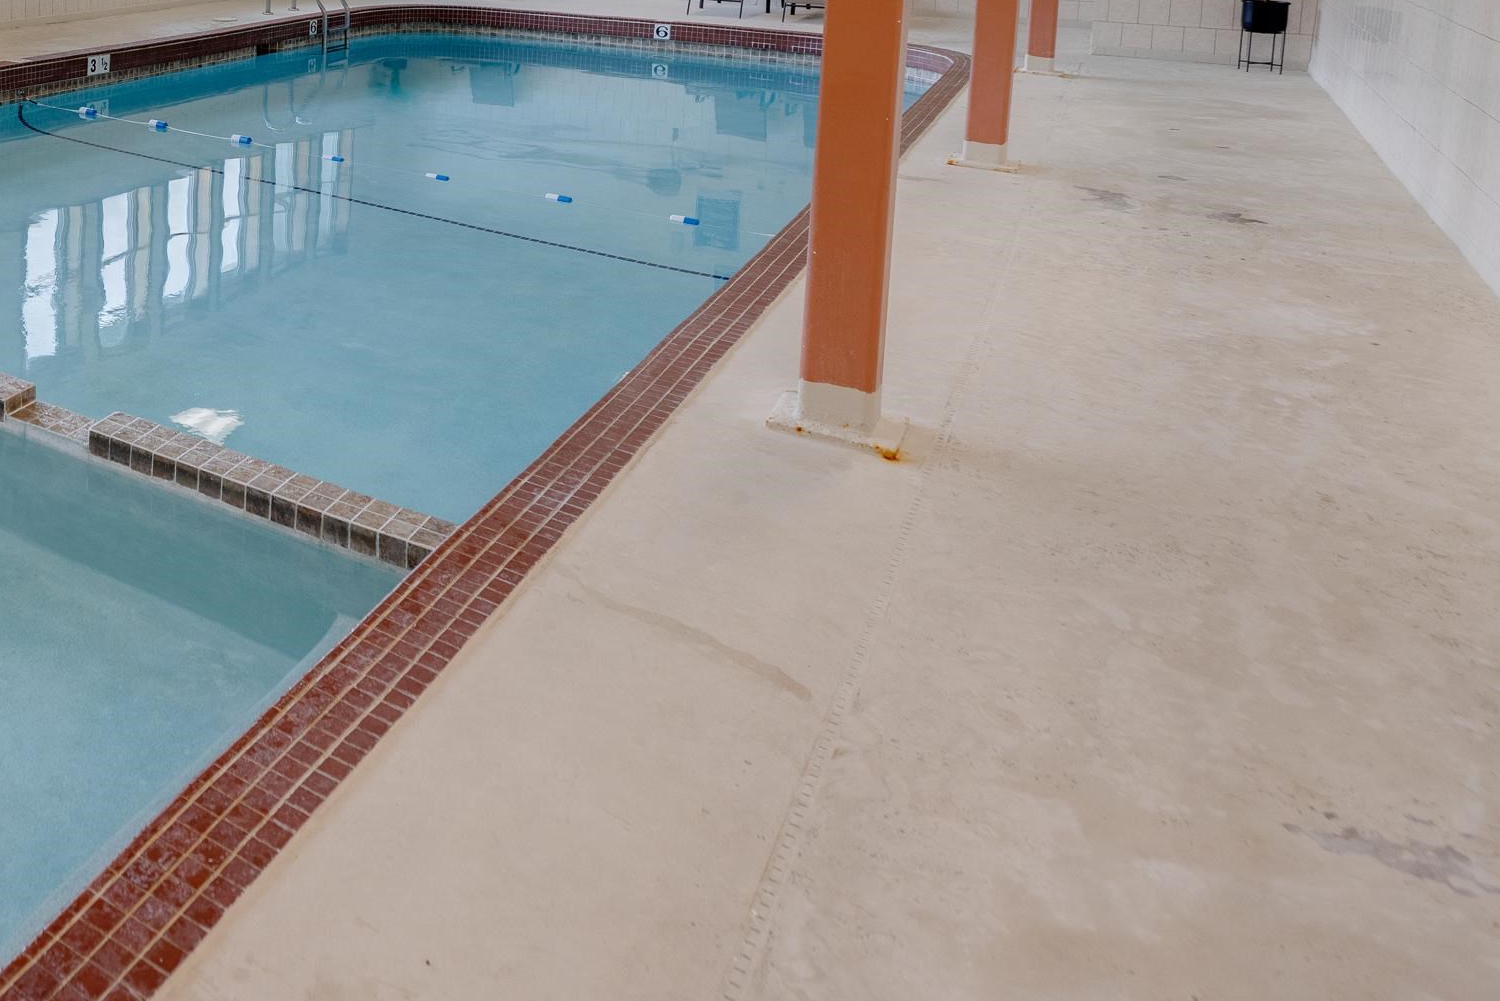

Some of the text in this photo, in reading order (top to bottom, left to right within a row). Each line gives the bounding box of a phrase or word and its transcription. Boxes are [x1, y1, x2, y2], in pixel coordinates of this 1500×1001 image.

[311, 21, 317, 34] 6
[655, 25, 668, 38] 6
[90, 58, 97, 73] 3
